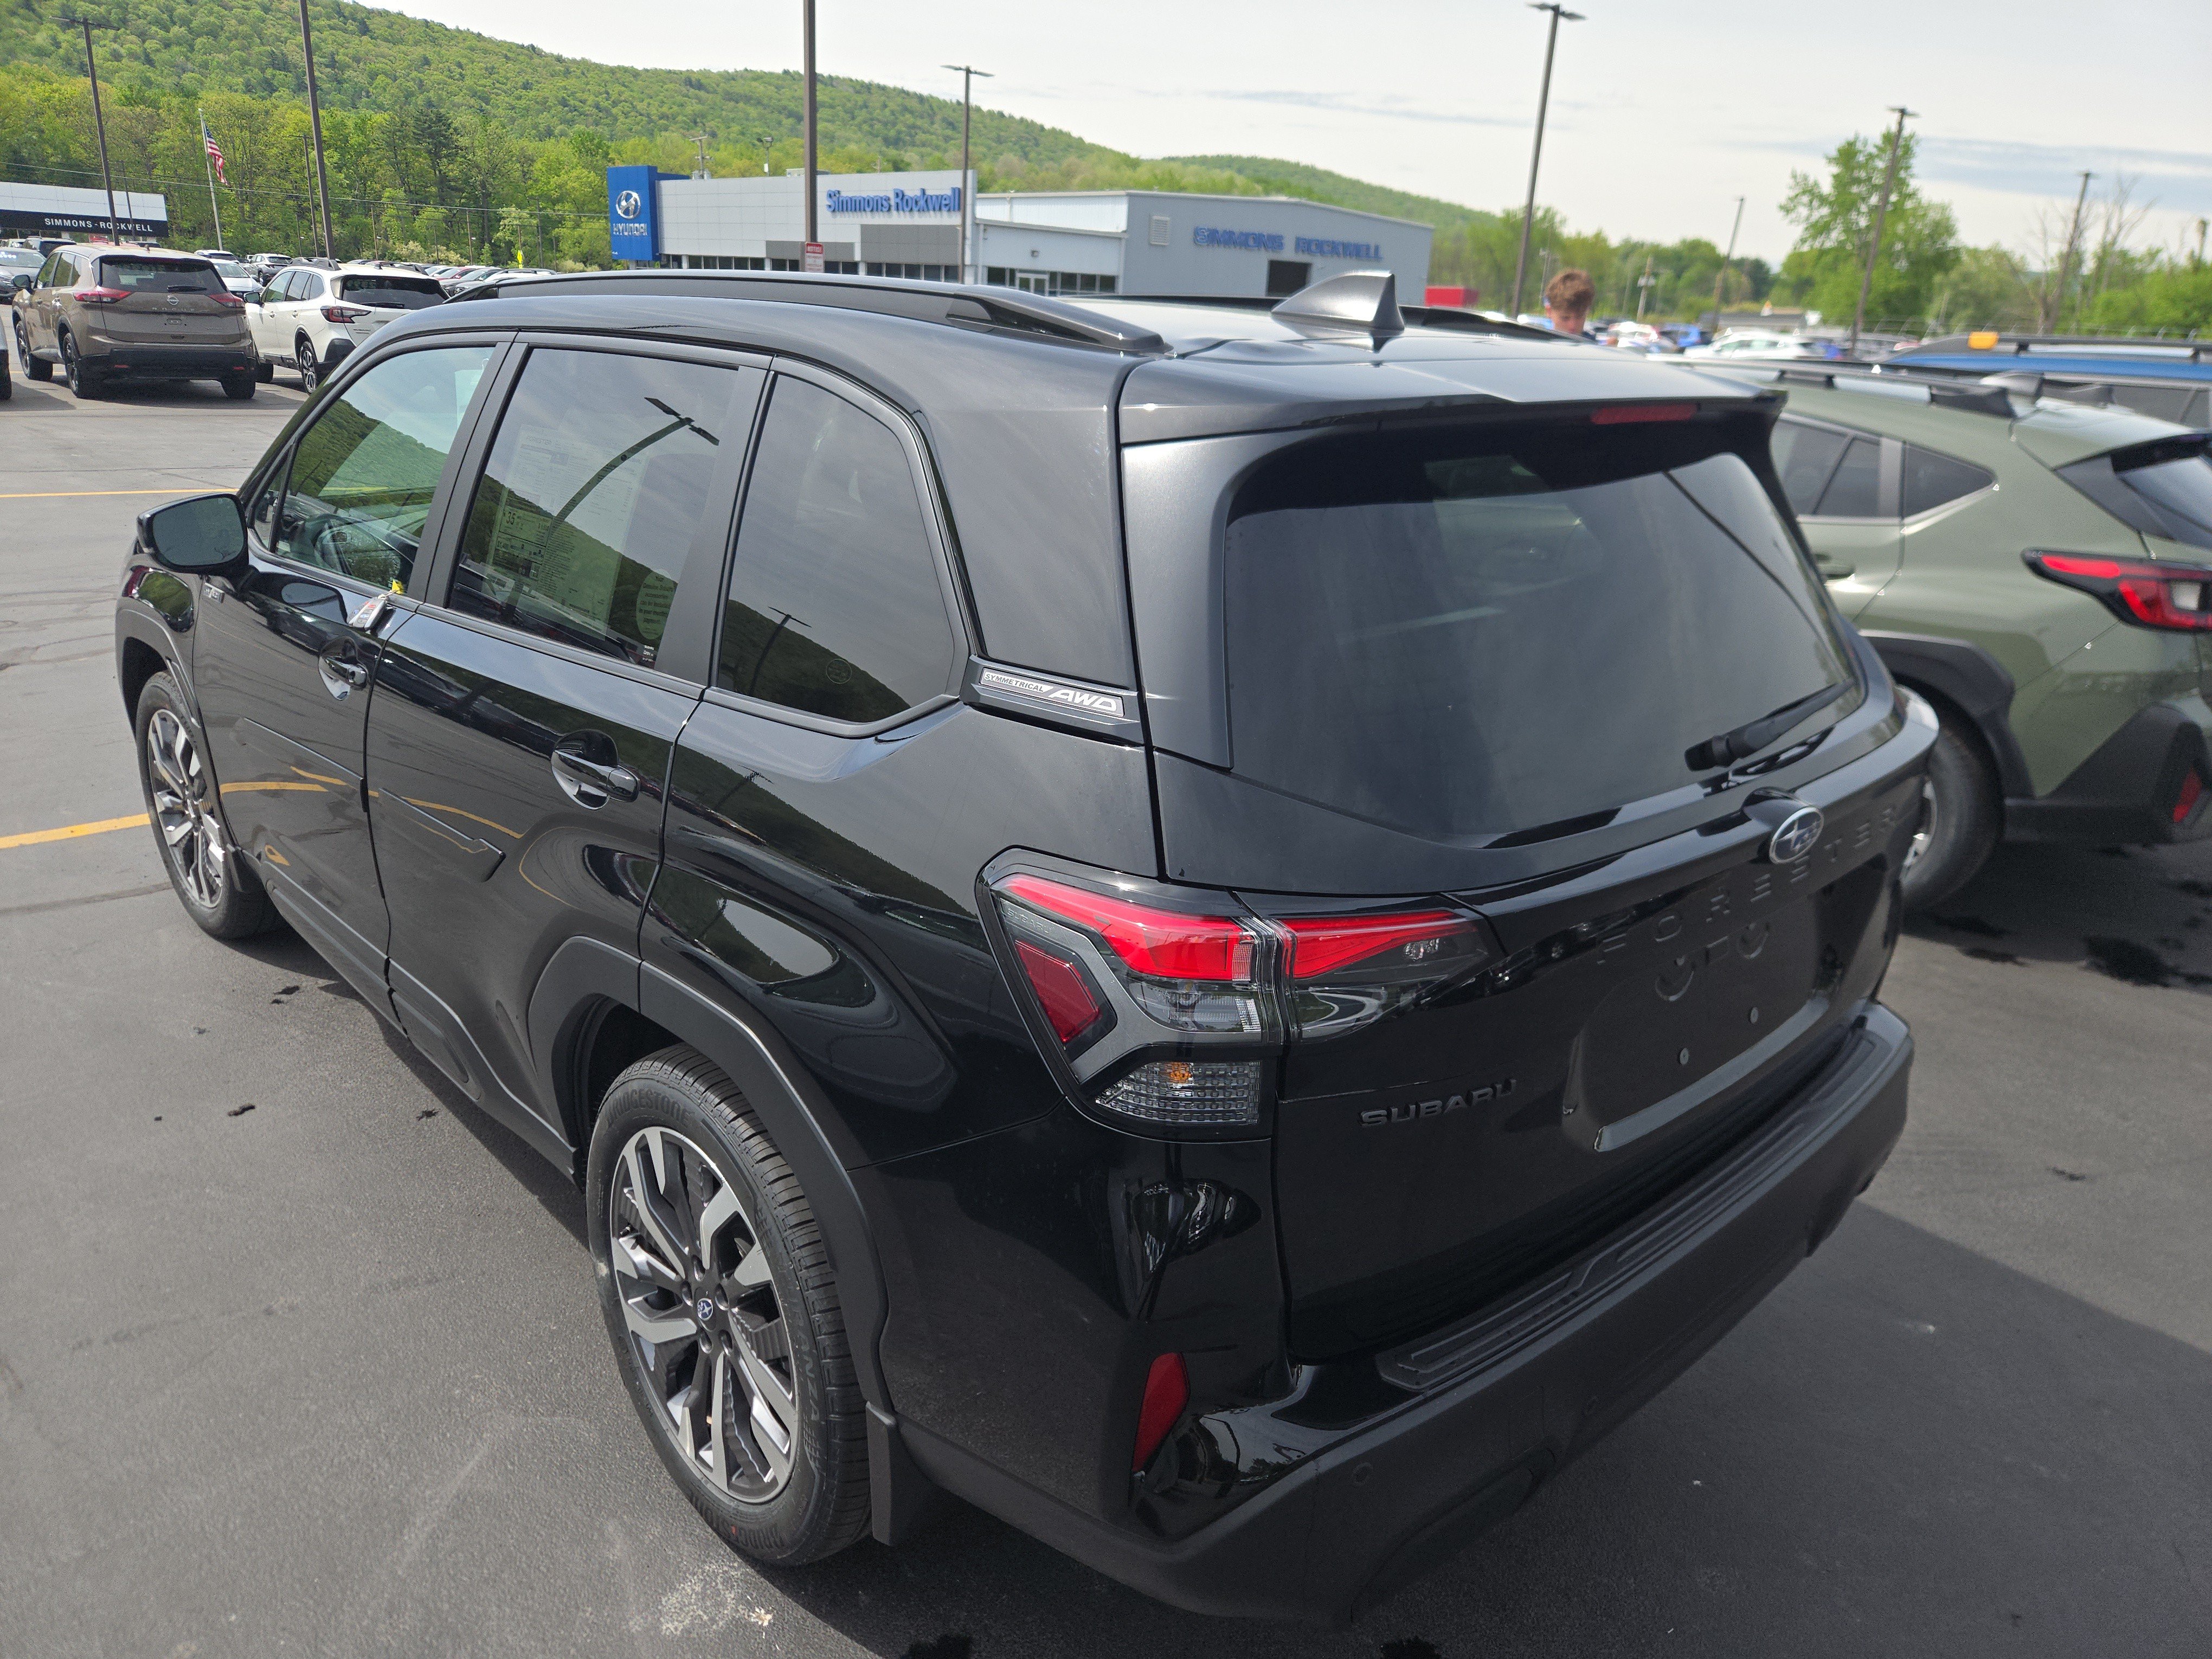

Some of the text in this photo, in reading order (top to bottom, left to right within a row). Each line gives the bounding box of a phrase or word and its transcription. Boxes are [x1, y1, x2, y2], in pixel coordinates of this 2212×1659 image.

[826, 187, 961, 212] Simmons Rockwell
[613, 223, 648, 236] HYUNDAI
[1194, 226, 1383, 260] SIMMONS ROCKWELL
[985, 673, 1117, 712] SYMMETRICAL AWD
[1597, 808, 1897, 965] FORESTER
[1359, 1078, 1517, 1127] SUBARU
